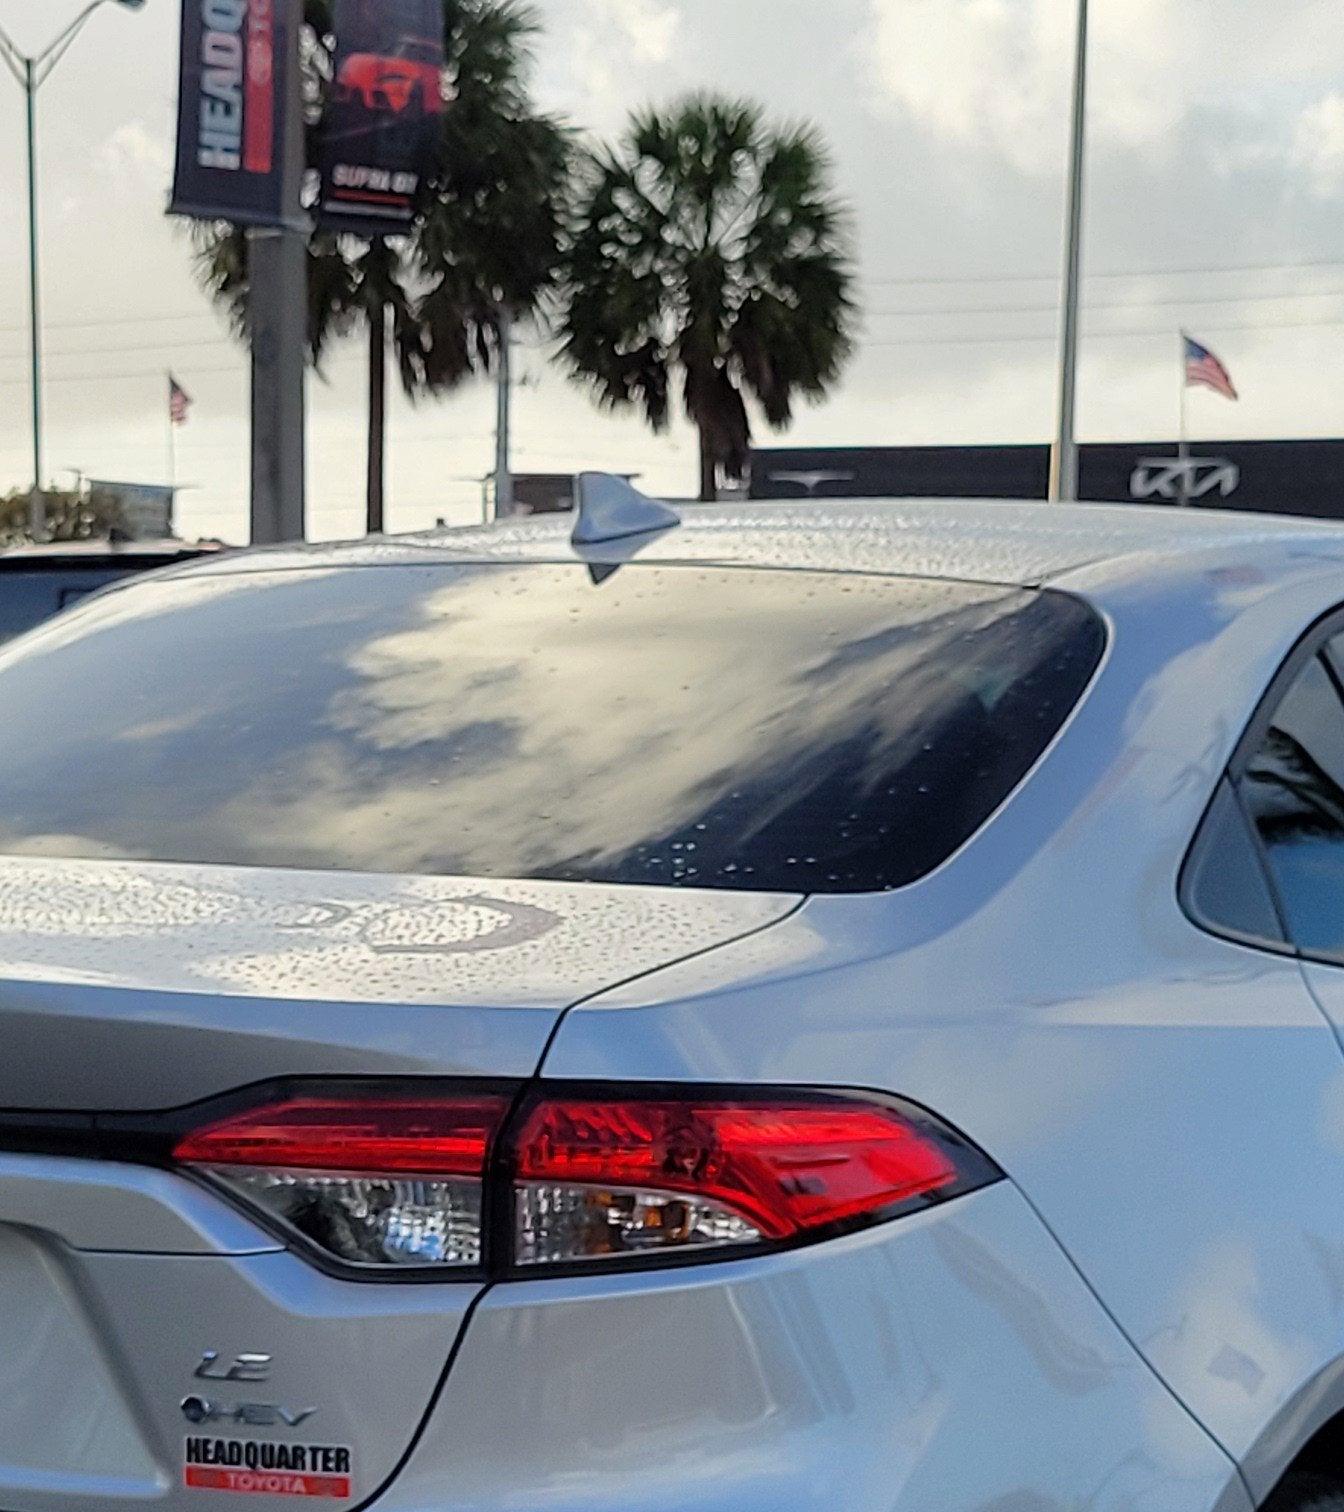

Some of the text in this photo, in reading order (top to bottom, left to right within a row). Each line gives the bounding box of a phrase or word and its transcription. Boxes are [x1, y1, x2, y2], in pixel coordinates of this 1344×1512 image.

[1130, 456, 1240, 498] KIA
[194, 1350, 273, 1382] LE
[186, 1436, 351, 1473] HEADQUARTER
[227, 1472, 307, 1495] TOYOTA
